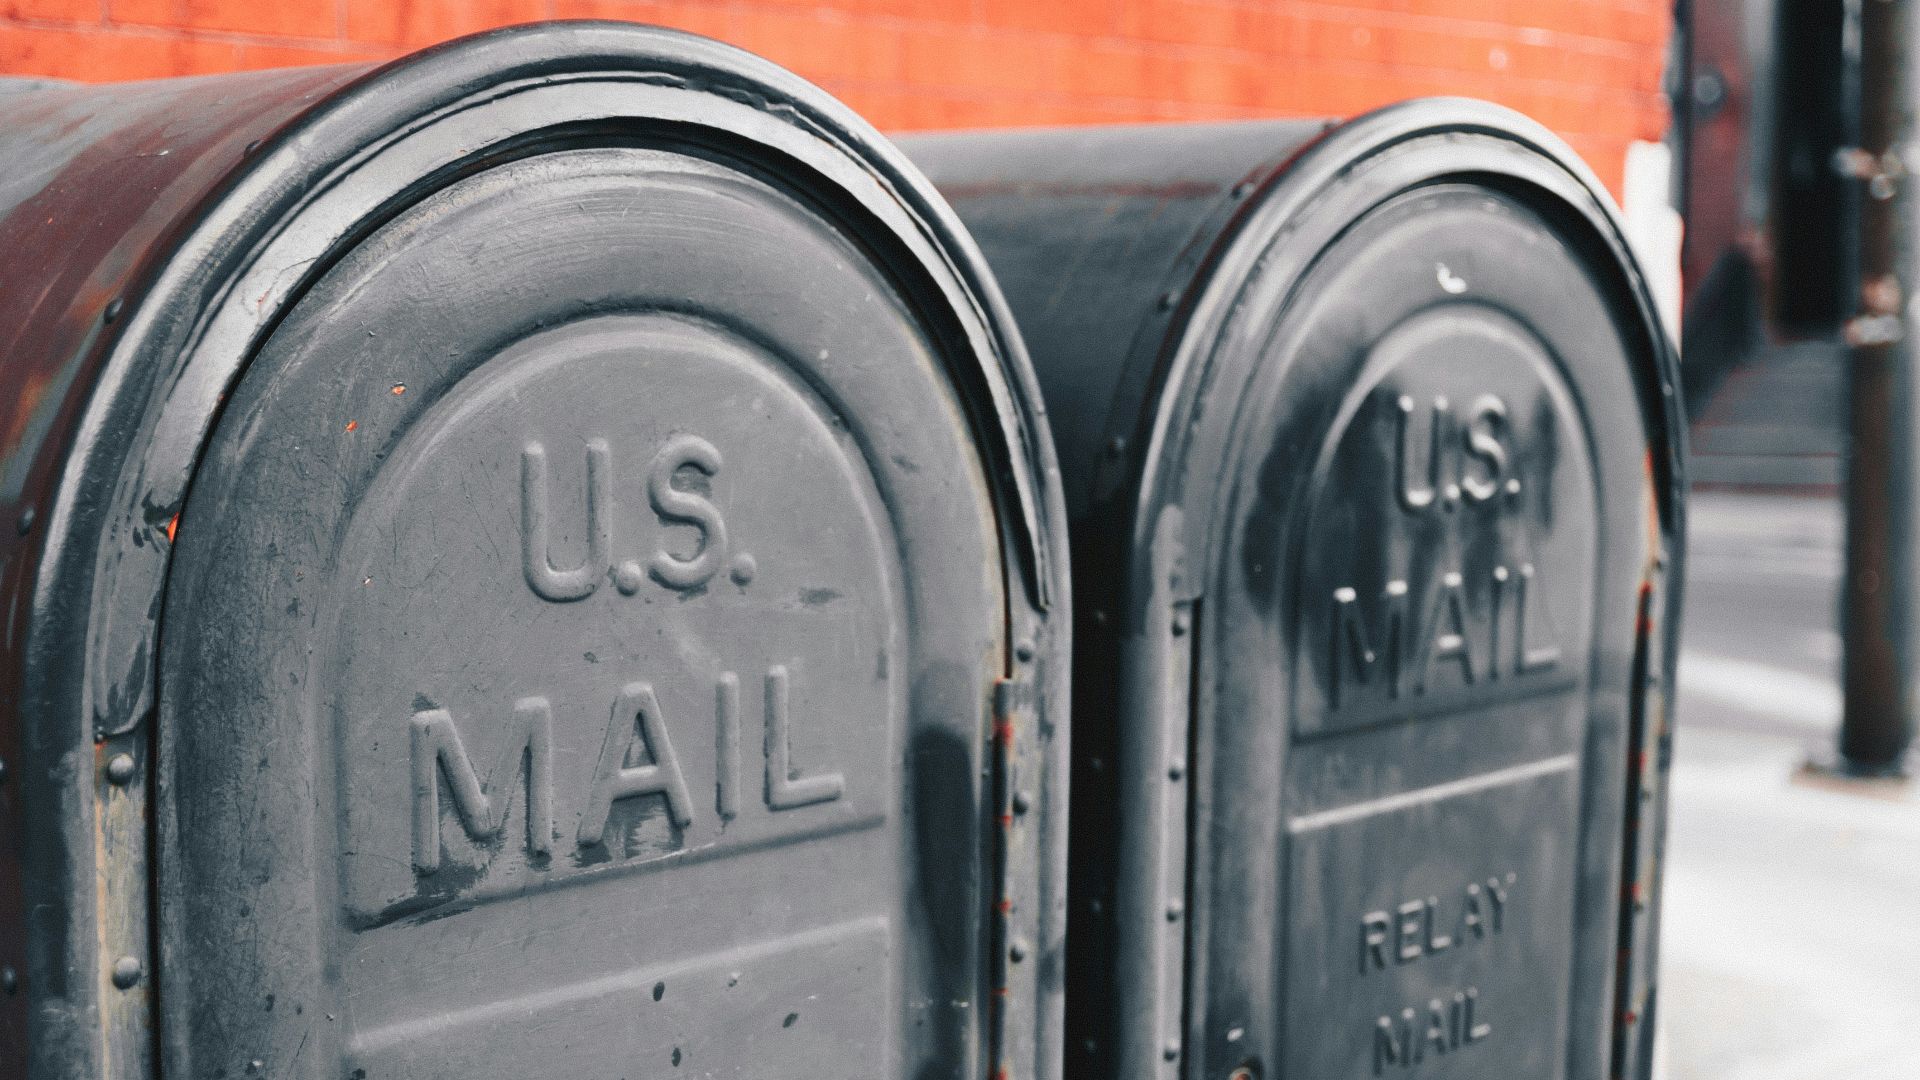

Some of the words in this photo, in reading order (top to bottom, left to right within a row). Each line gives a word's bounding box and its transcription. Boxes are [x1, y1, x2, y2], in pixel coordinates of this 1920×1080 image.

[521, 433, 757, 602] U.S.
[1396, 394, 1521, 510] U.S.
[1330, 562, 1561, 711] MAIL
[409, 664, 845, 876] MAIL
[1358, 872, 1516, 976] RELAY
[1373, 986, 1491, 1076] MAIL
